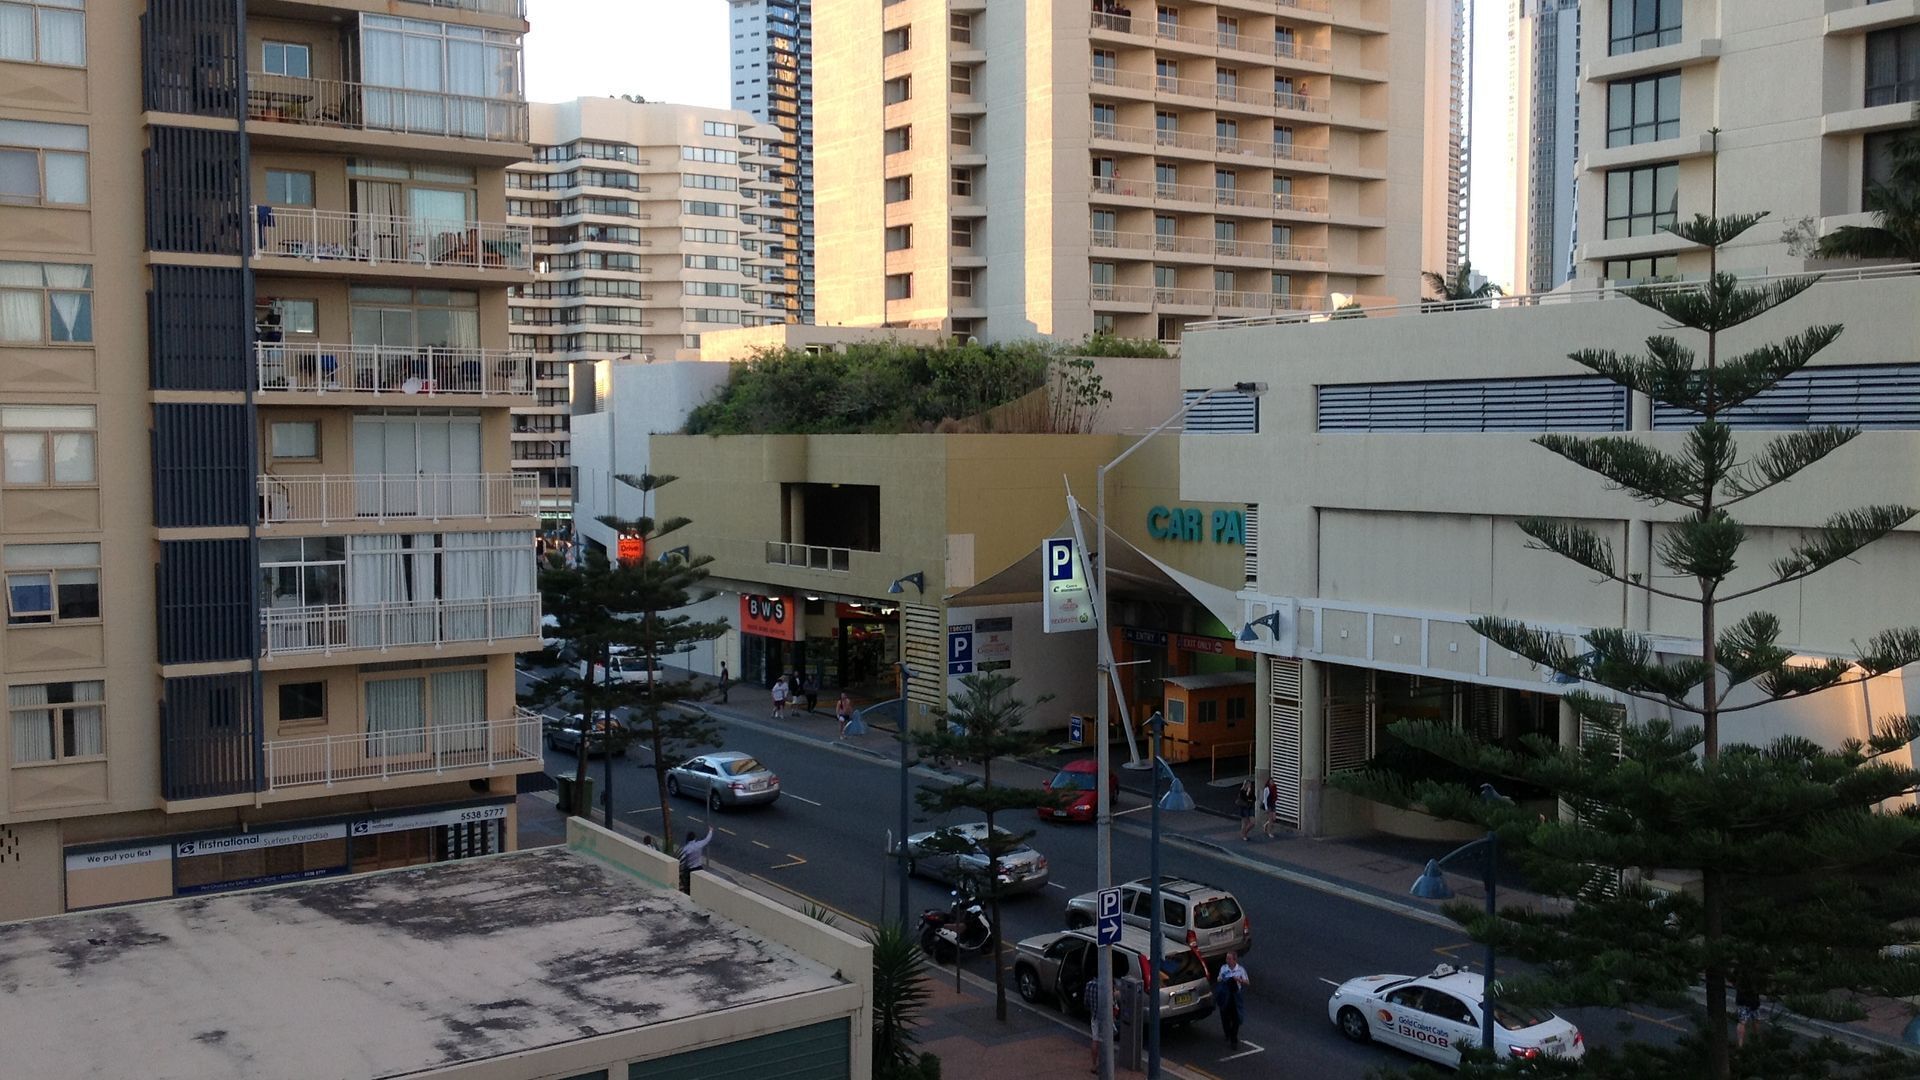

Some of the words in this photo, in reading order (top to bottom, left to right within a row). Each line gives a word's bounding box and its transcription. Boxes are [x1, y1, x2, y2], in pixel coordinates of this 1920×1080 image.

[1147, 506, 1203, 542] CAR
[1211, 510, 1247, 545] PA
[1052, 545, 1071, 577] P
[750, 599, 783, 619] BWS
[1135, 632, 1155, 642] ENTRY
[1183, 638, 1197, 649] EXIT
[1197, 640, 1212, 651] ONLY
[954, 637, 968, 658] P
[461, 812, 481, 821] 5538
[484, 808, 504, 818] 5777
[198, 835, 259, 850] firstnational
[263, 836, 290, 846] Surfers
[292, 832, 329, 842] Paradise
[103, 853, 117, 863] put
[119, 852, 135, 860] you
[137, 849, 151, 857] first
[1103, 893, 1117, 916] P
[1398, 1016, 1413, 1027] Gold
[1413, 1021, 1432, 1033] Coast
[1432, 1027, 1449, 1037] Cabs
[1398, 1025, 1449, 1048] 131008
